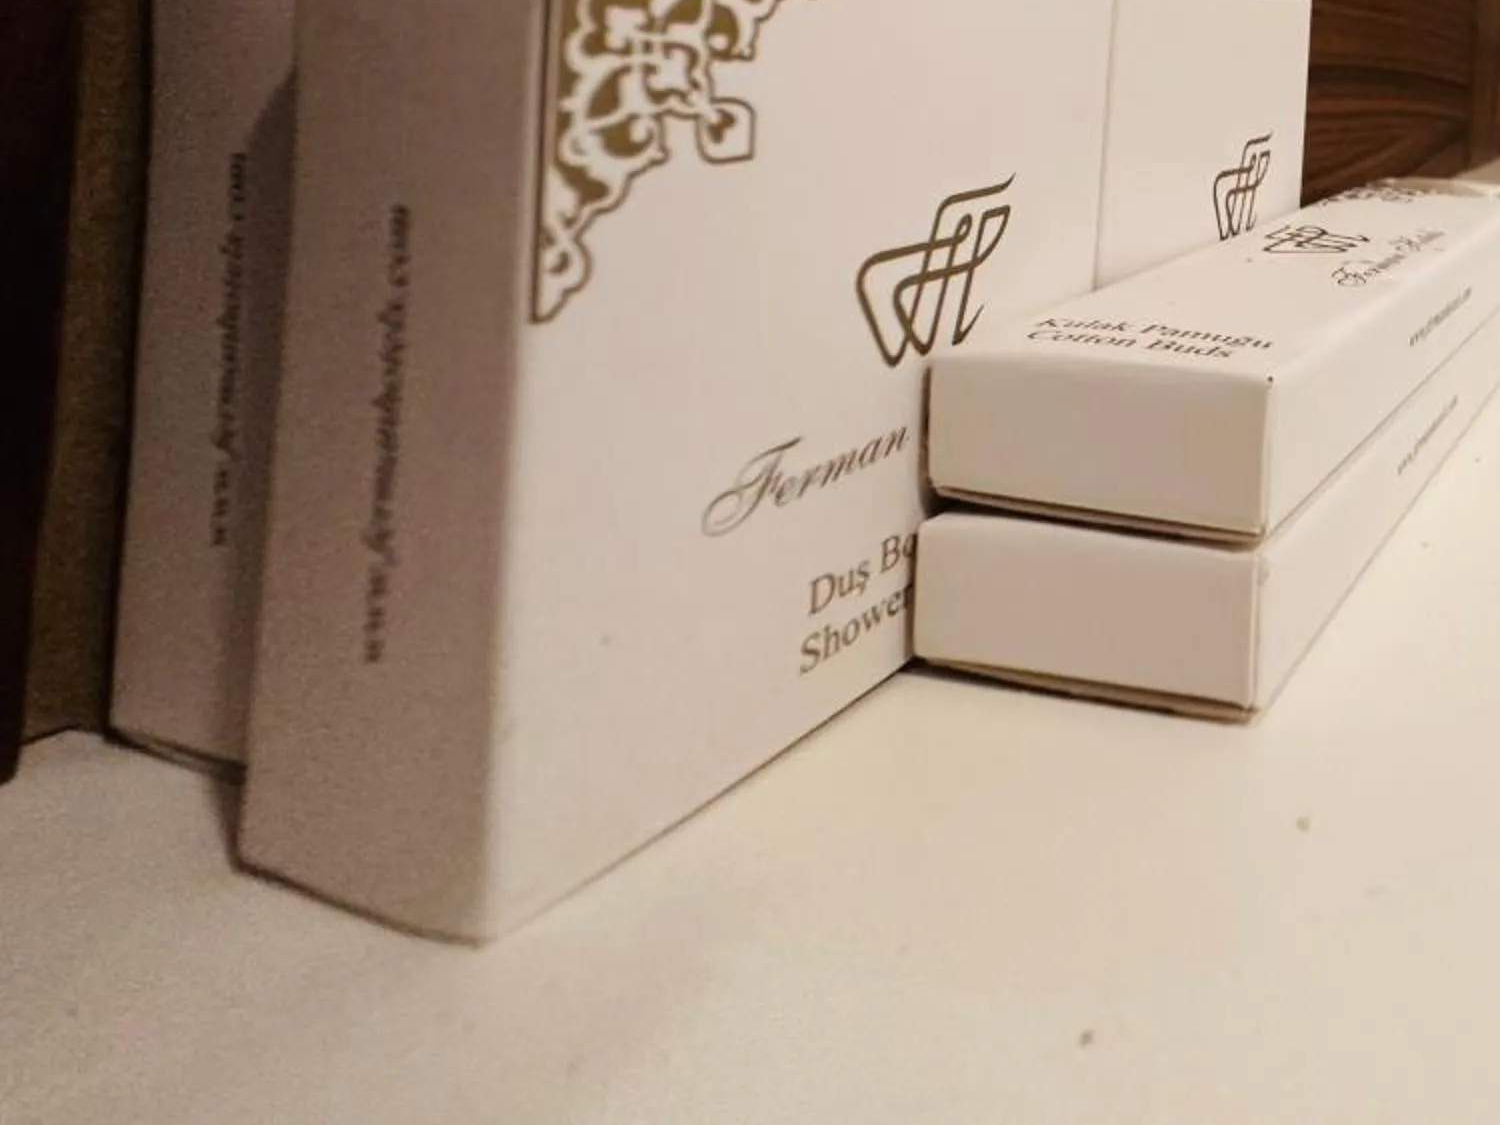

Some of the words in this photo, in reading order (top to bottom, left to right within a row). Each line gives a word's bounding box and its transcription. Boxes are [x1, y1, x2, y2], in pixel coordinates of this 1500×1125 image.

[1026, 330, 1137, 348] Cotton
[1143, 338, 1233, 359] Buds
[1035, 318, 1128, 332] Kulak
[701, 425, 908, 537] Ferman
[808, 559, 869, 617] Duş
